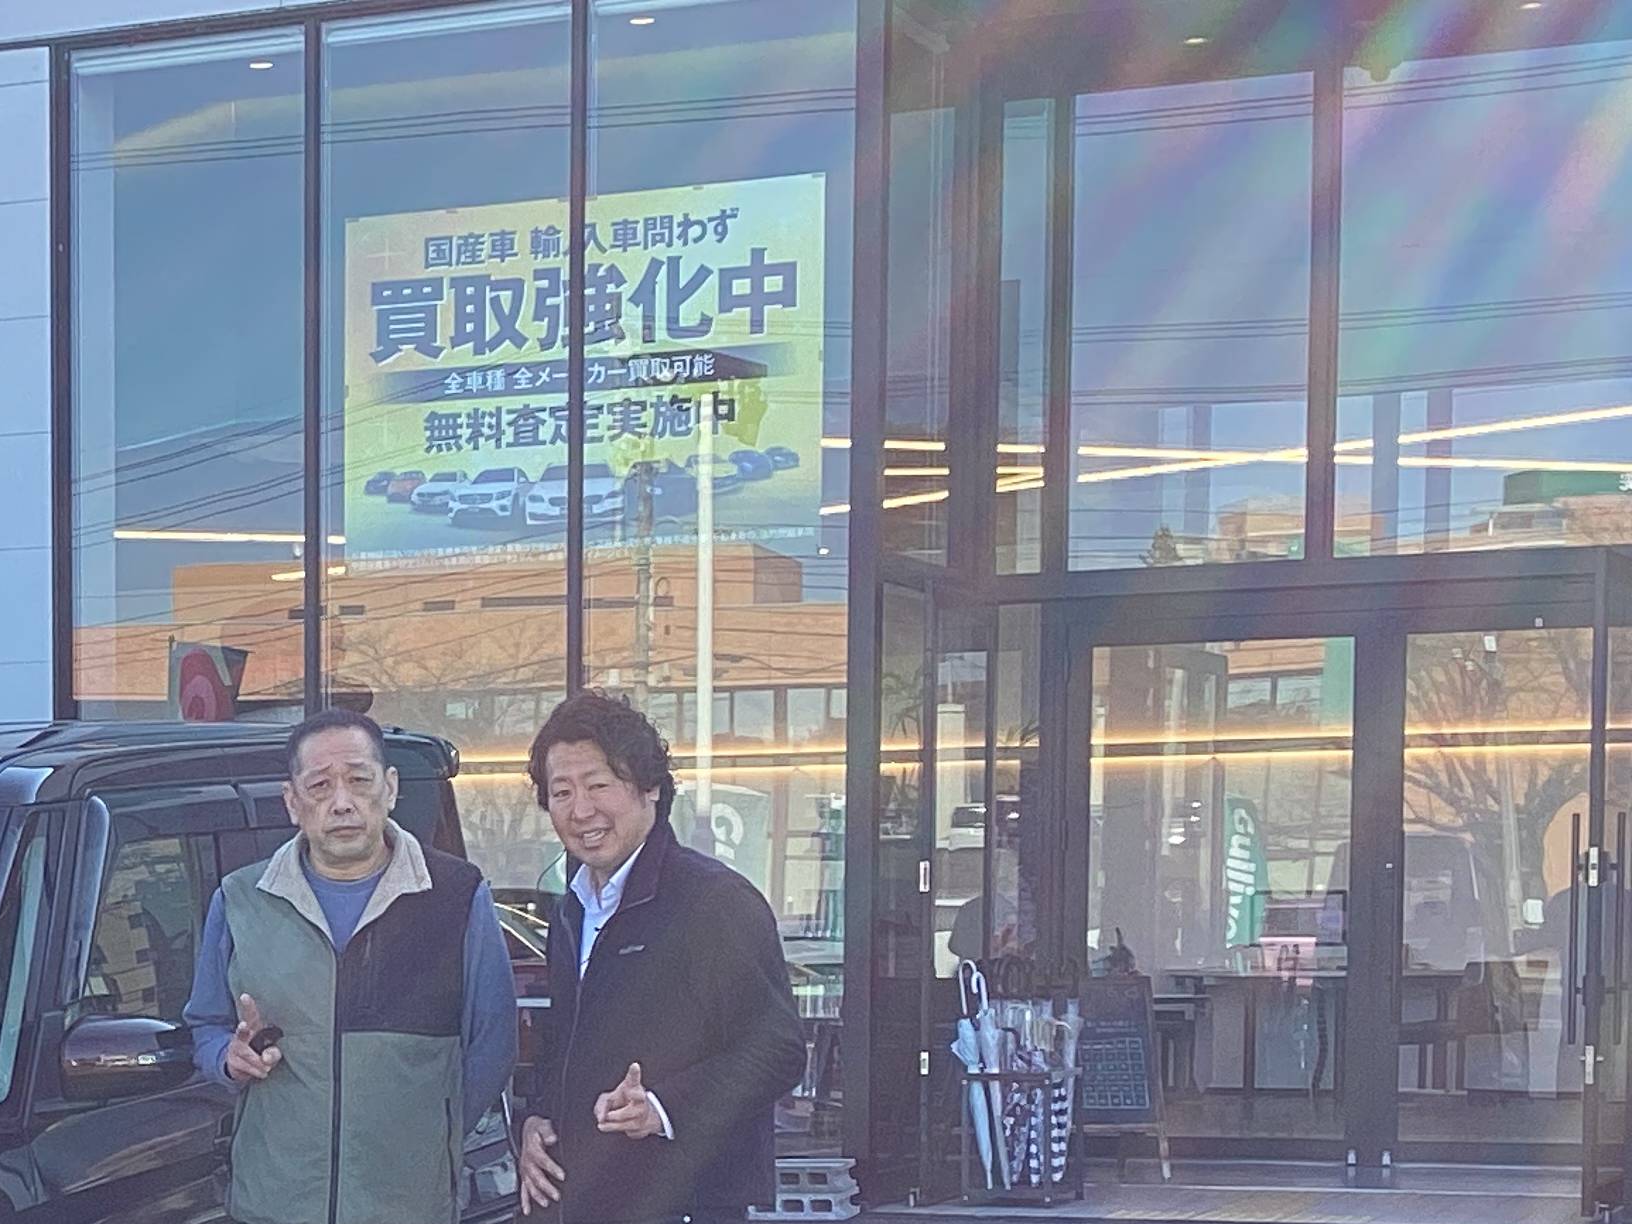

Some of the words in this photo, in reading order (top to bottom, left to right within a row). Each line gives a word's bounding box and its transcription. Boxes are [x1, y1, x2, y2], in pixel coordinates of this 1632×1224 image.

[424, 230, 519, 269] 国産車
[529, 207, 740, 260] 輸入車問わず
[369, 247, 798, 364] 買取強化中
[443, 369, 506, 395] 全車種
[513, 352, 715, 391] 全メーカー買取可能
[423, 390, 738, 456] 無料査定実施中
